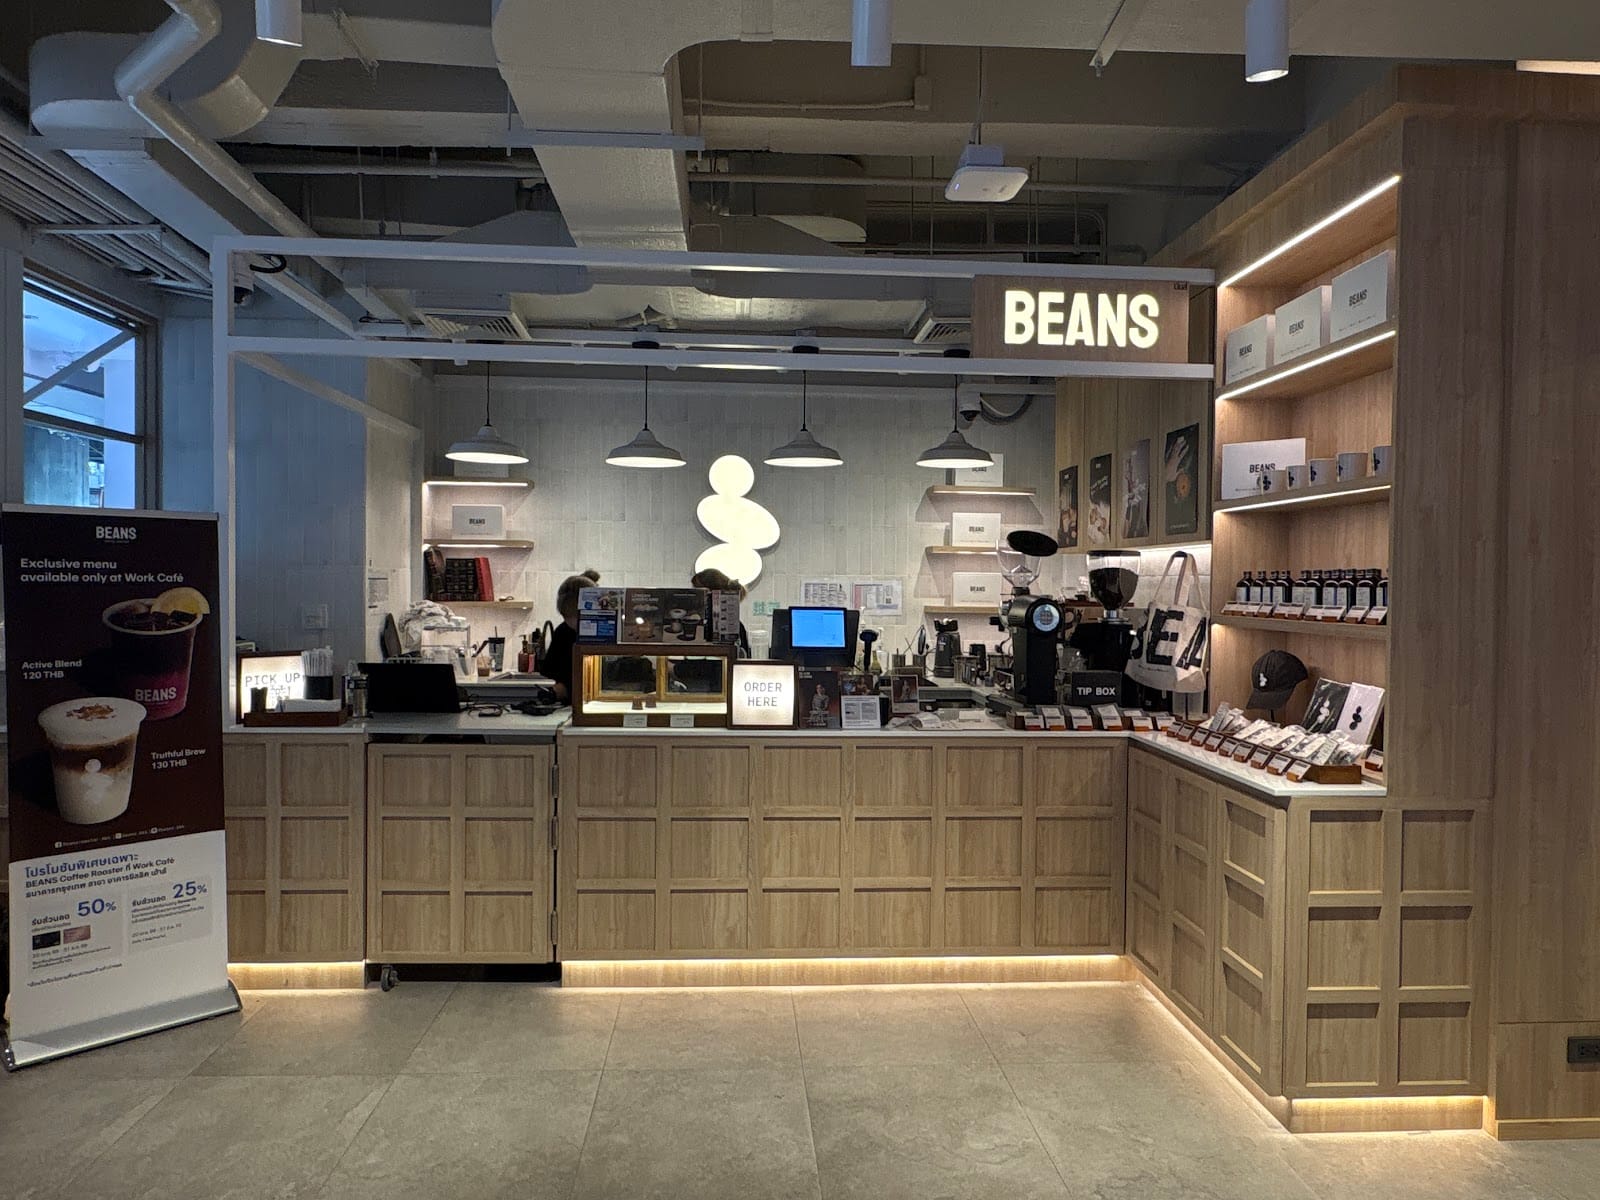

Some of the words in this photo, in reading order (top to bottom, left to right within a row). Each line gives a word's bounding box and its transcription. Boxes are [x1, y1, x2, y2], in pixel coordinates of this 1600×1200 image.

[1348, 289, 1368, 306] BEANS
[1004, 290, 1159, 349] BEANS
[1288, 320, 1304, 335] BEANS
[1239, 344, 1252, 357] BEANS
[1249, 462, 1276, 473] BEANS
[95, 526, 137, 540] BEANS
[20, 558, 81, 569] Exclusive
[83, 560, 117, 570] menu
[20, 572, 79, 583] available
[82, 573, 107, 584] only
[109, 574, 122, 583] at
[125, 573, 155, 583] Work
[157, 573, 184, 583] Café
[22, 660, 53, 670] Active
[55, 659, 82, 669] Blend
[23, 670, 42, 680] 120
[43, 670, 64, 679] THB
[245, 674, 277, 687] PICK
[285, 672, 301, 683] UP
[744, 682, 782, 692] ORDER
[1077, 687, 1092, 696] TIP
[1095, 687, 1116, 696] BOX
[135, 687, 177, 702] BEANS
[747, 696, 777, 707] HERE
[151, 750, 184, 760] Truthful
[185, 748, 206, 757] Brew
[152, 761, 169, 769] 130
[170, 759, 187, 768] THB
[26, 877, 57, 888] BEANS
[60, 872, 89, 882] Coffee
[133, 860, 153, 870] Work
[172, 881, 207, 899] 25%
[77, 898, 117, 917] 50%
